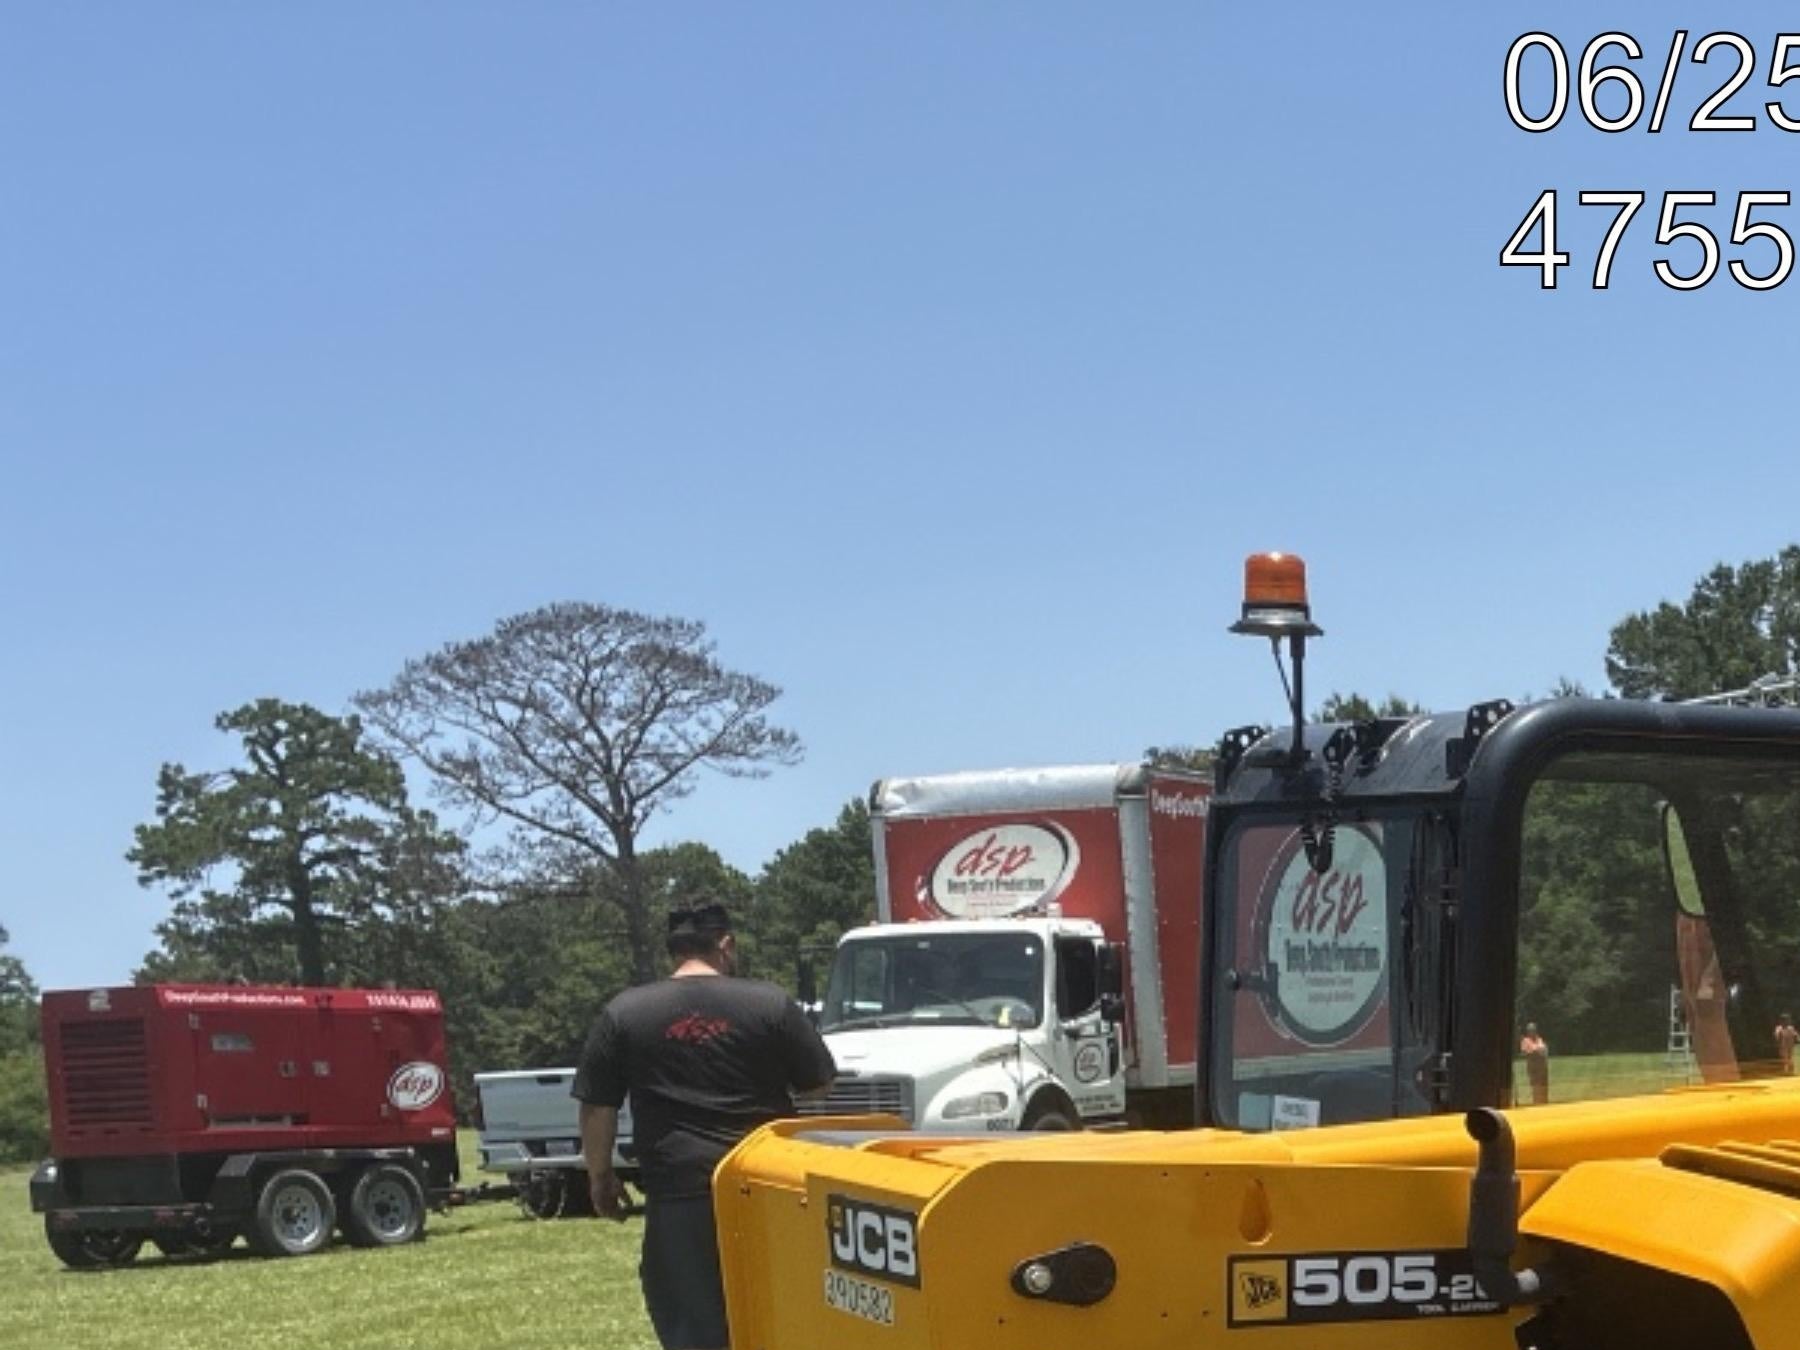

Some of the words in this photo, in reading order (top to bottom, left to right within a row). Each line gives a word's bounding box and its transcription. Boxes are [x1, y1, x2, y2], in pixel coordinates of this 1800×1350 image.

[955, 833, 1035, 878] dsp
[832, 1207, 917, 1276] JCB
[825, 1270, 893, 1324] 390582
[1292, 1255, 1489, 1307] 505-2
